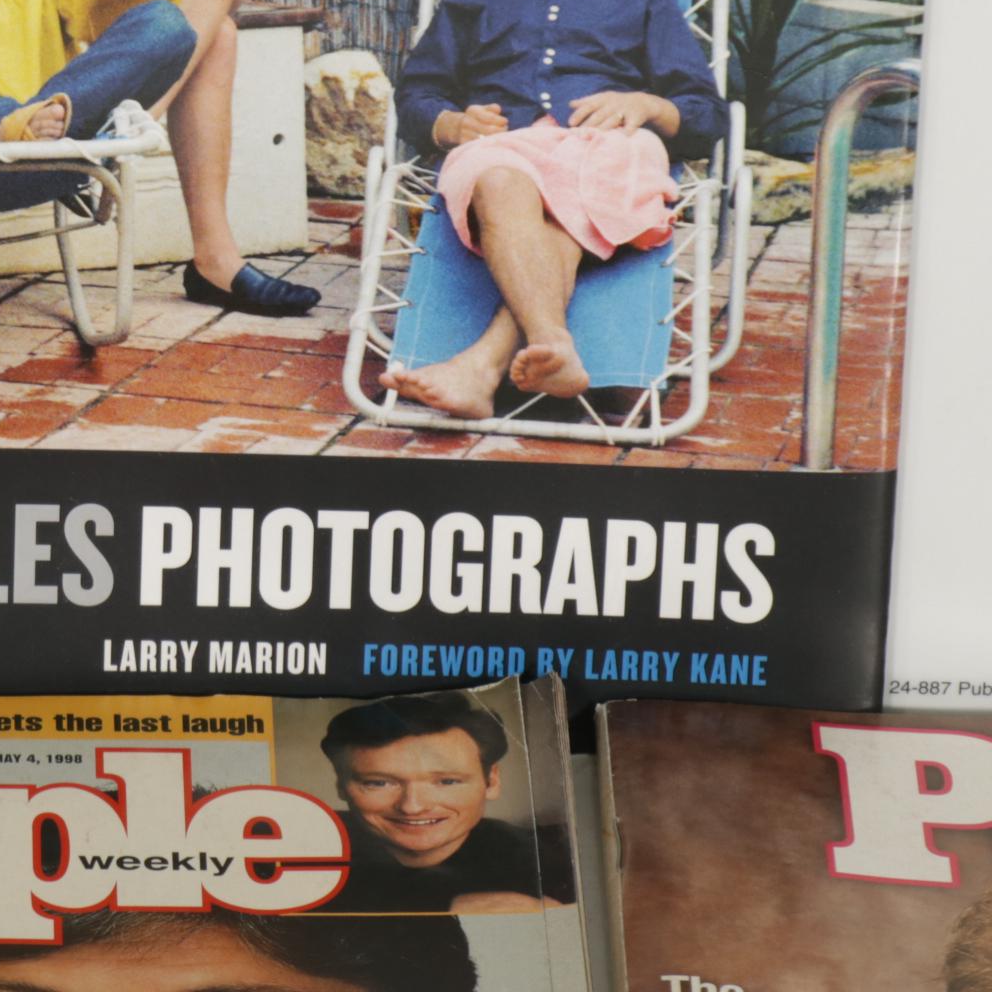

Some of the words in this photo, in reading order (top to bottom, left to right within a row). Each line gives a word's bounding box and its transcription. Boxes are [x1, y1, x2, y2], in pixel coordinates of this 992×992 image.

[139, 505, 776, 624] PHOTOGRAPHS
[103, 639, 197, 674] LARRY
[209, 641, 327, 676] MARION
[363, 643, 525, 678] FOREWORD
[537, 647, 575, 679] BY
[584, 649, 680, 683] LARRY
[690, 653, 769, 687] KANE
[889, 680, 952, 696] 24-887
[54, 713, 103, 732] the
[113, 714, 172, 733] last
[182, 714, 265, 736] laugh
[26, 753, 41, 766] 4,
[46, 754, 83, 765] 1998
[78, 850, 235, 877] weekly
